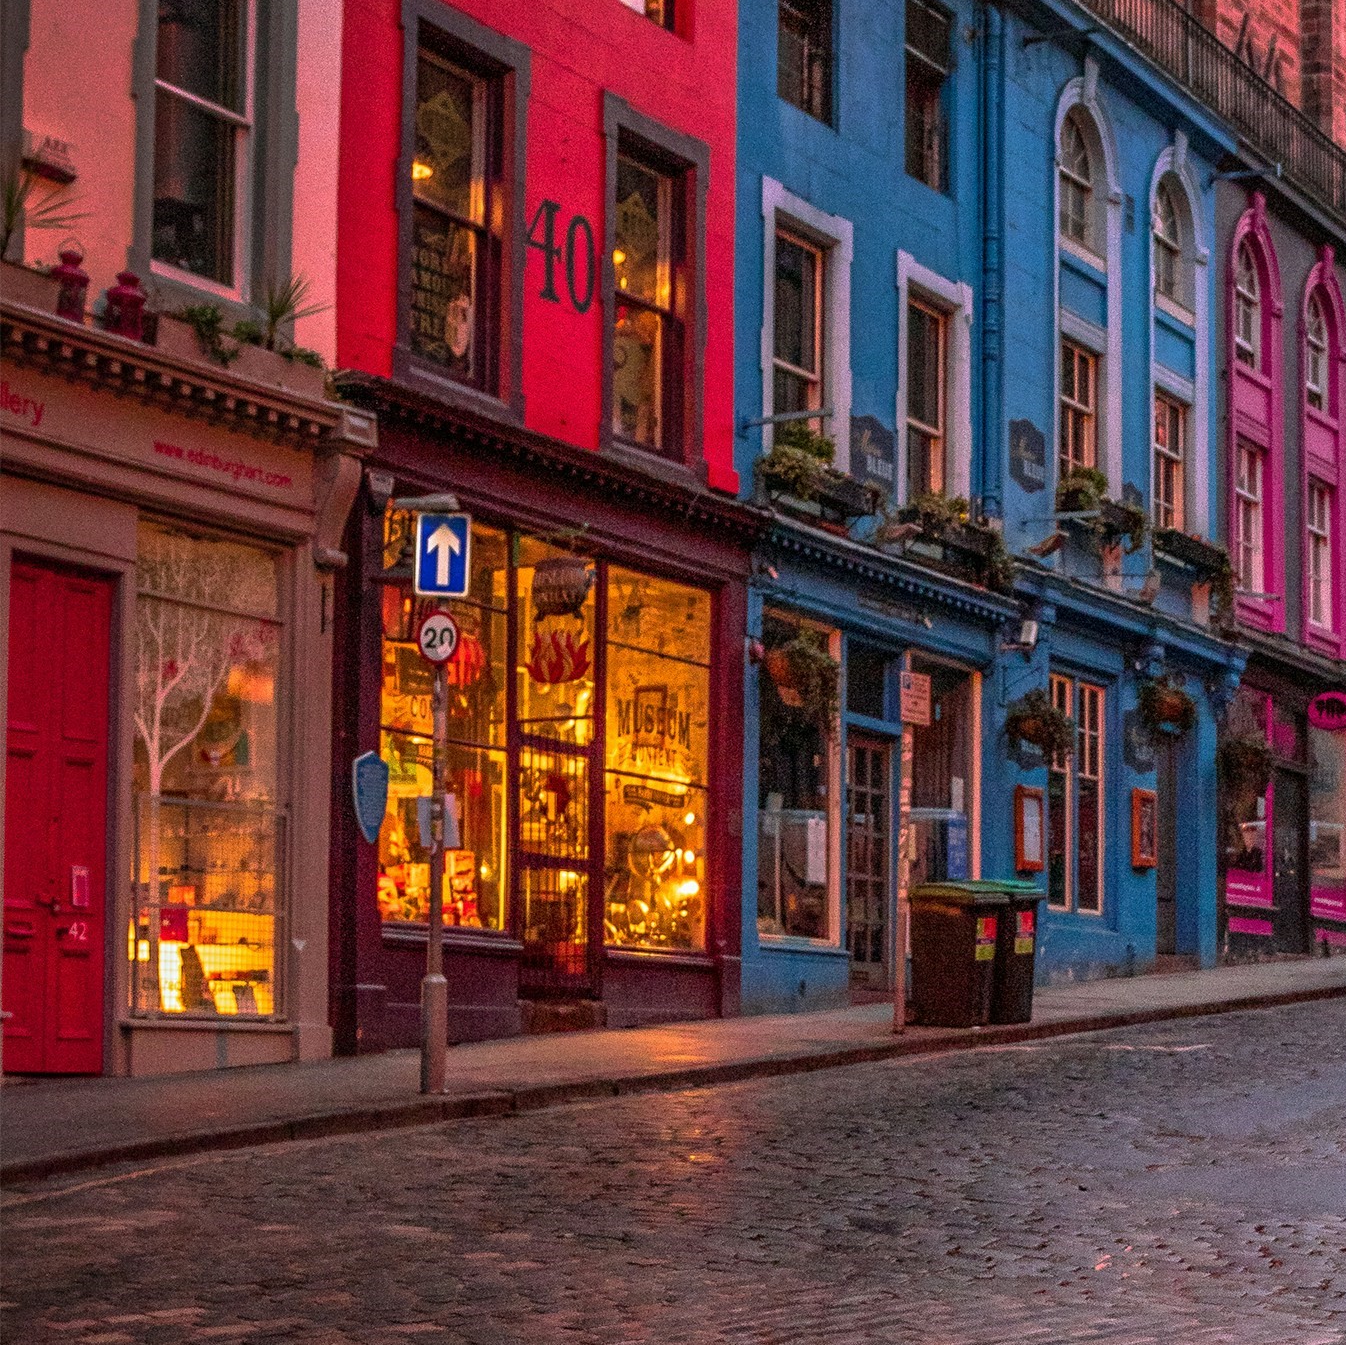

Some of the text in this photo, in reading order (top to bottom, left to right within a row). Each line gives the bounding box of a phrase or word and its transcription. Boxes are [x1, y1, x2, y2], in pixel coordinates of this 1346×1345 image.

[525, 200, 595, 314] 40
[424, 627, 455, 650] 20
[617, 698, 692, 751] MUSEUM
[68, 921, 88, 941] 42
